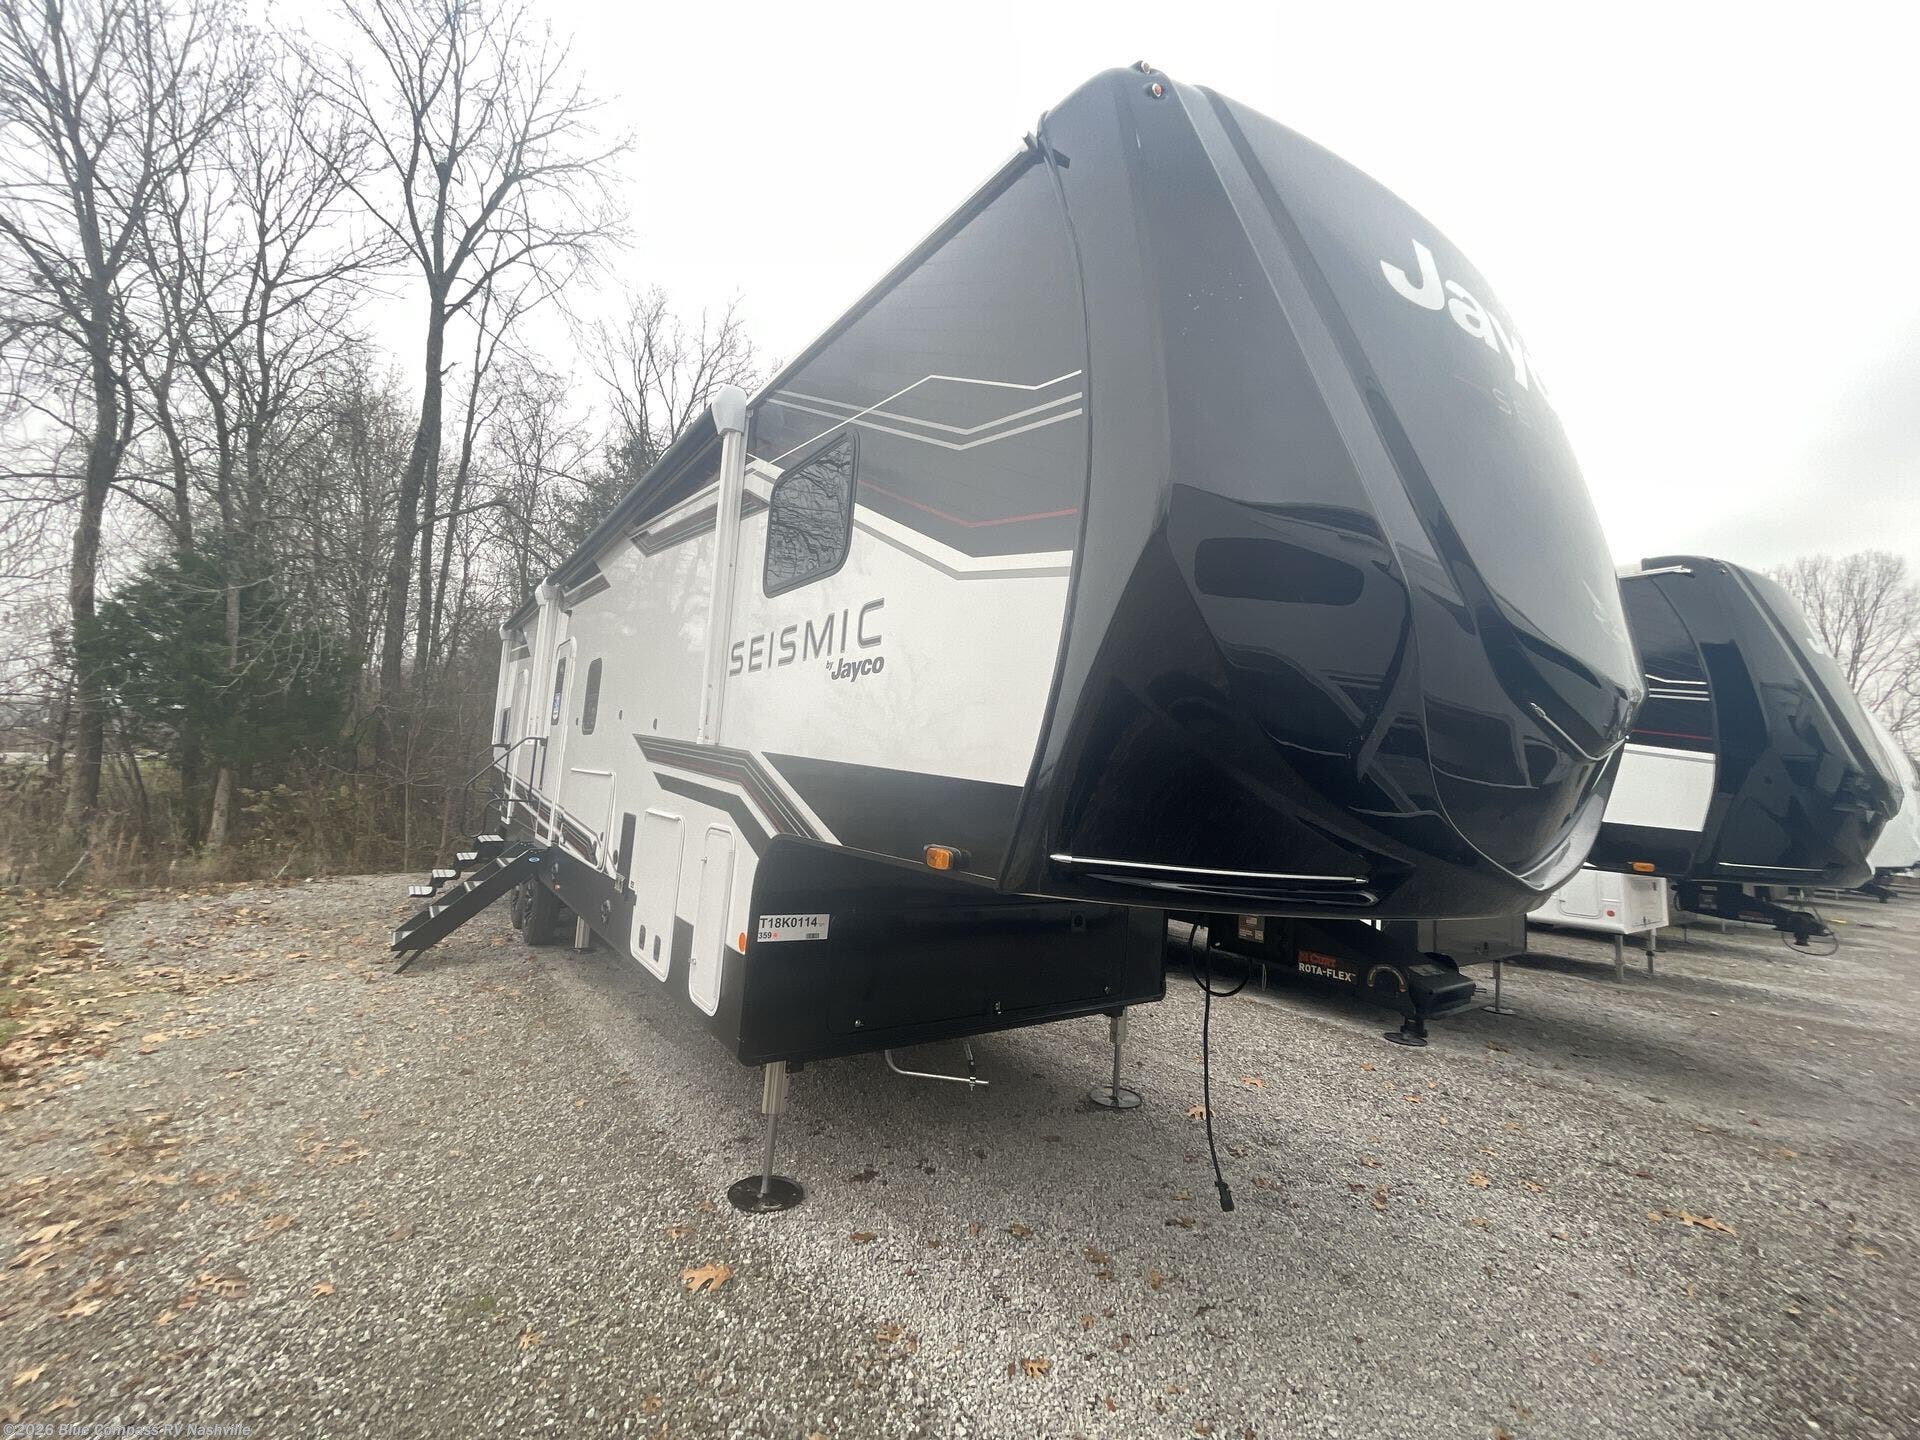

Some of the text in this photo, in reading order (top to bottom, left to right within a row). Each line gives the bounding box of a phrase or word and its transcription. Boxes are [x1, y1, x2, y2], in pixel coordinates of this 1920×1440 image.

[729, 597, 885, 677] SEISMIC
[826, 656, 885, 682] by Jayco
[760, 917, 818, 929] T18K0114
[1298, 962, 1352, 982] ROTA-FLEX
